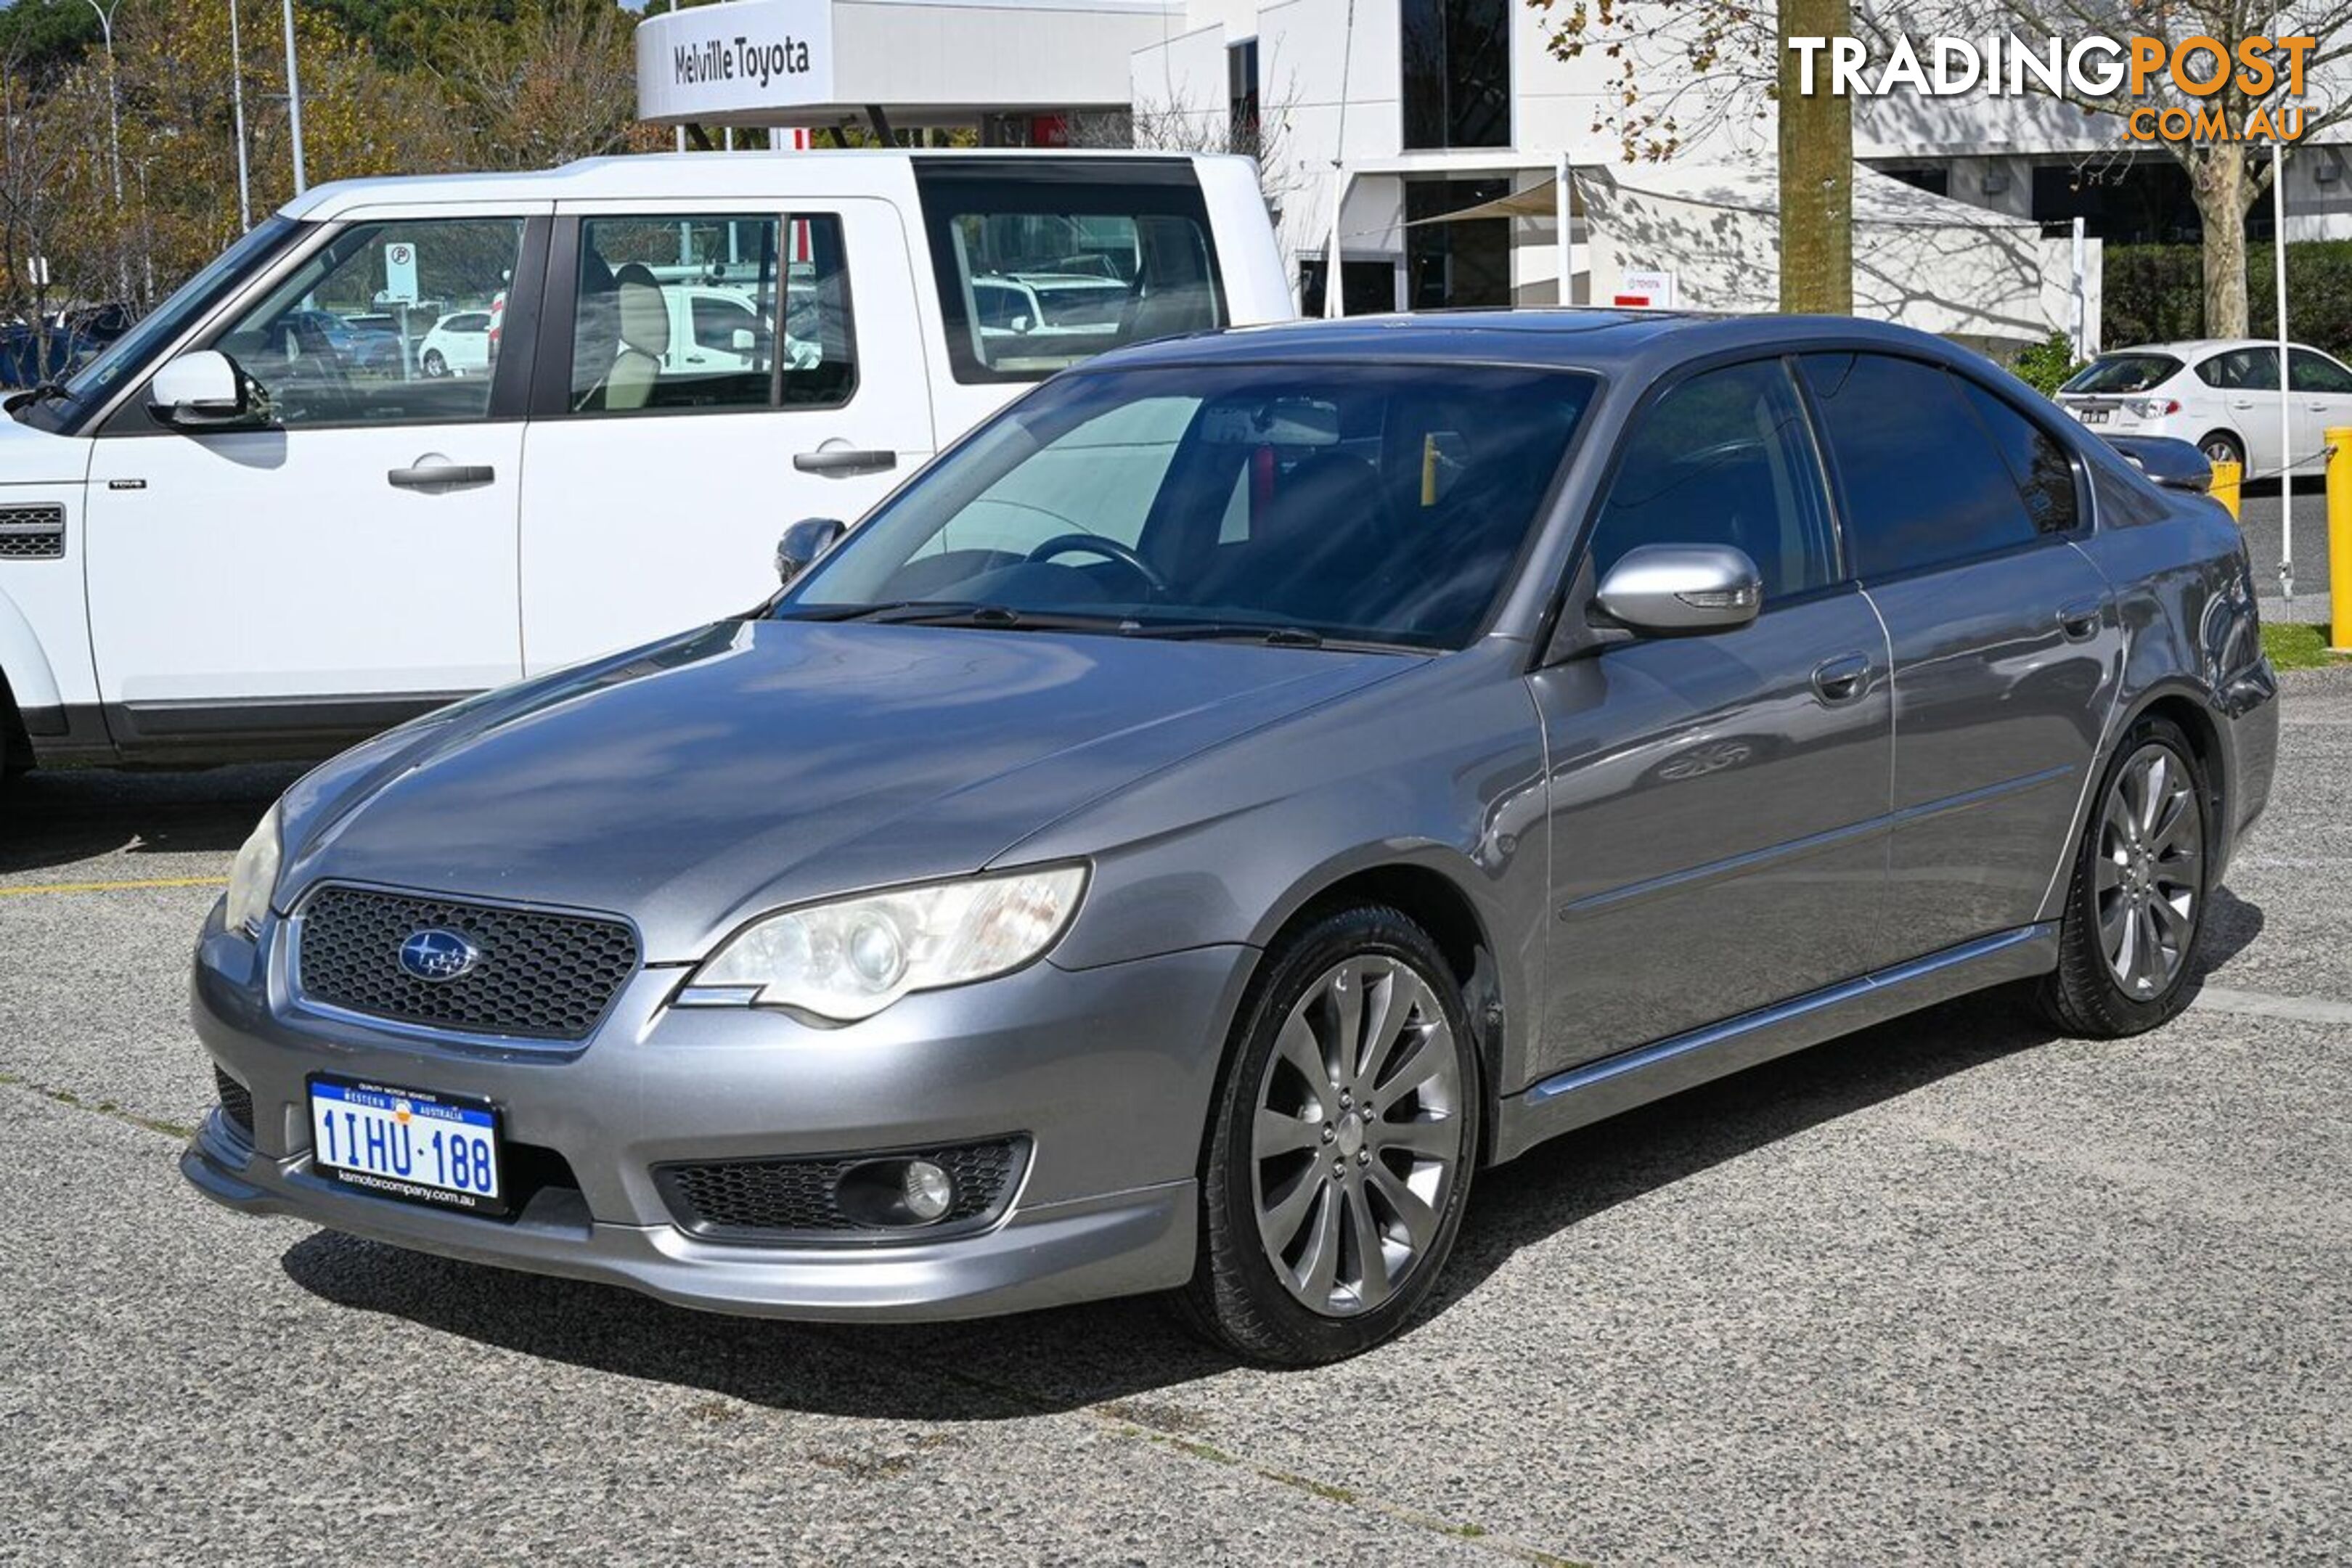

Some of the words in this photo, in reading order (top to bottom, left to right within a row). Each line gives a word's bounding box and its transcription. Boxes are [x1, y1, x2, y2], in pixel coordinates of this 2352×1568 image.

[674, 40, 733, 84] Melville
[735, 36, 810, 88] Toyota
[344, 1090, 385, 1108] WESTERN
[420, 1106, 464, 1122] AUSTRALIA
